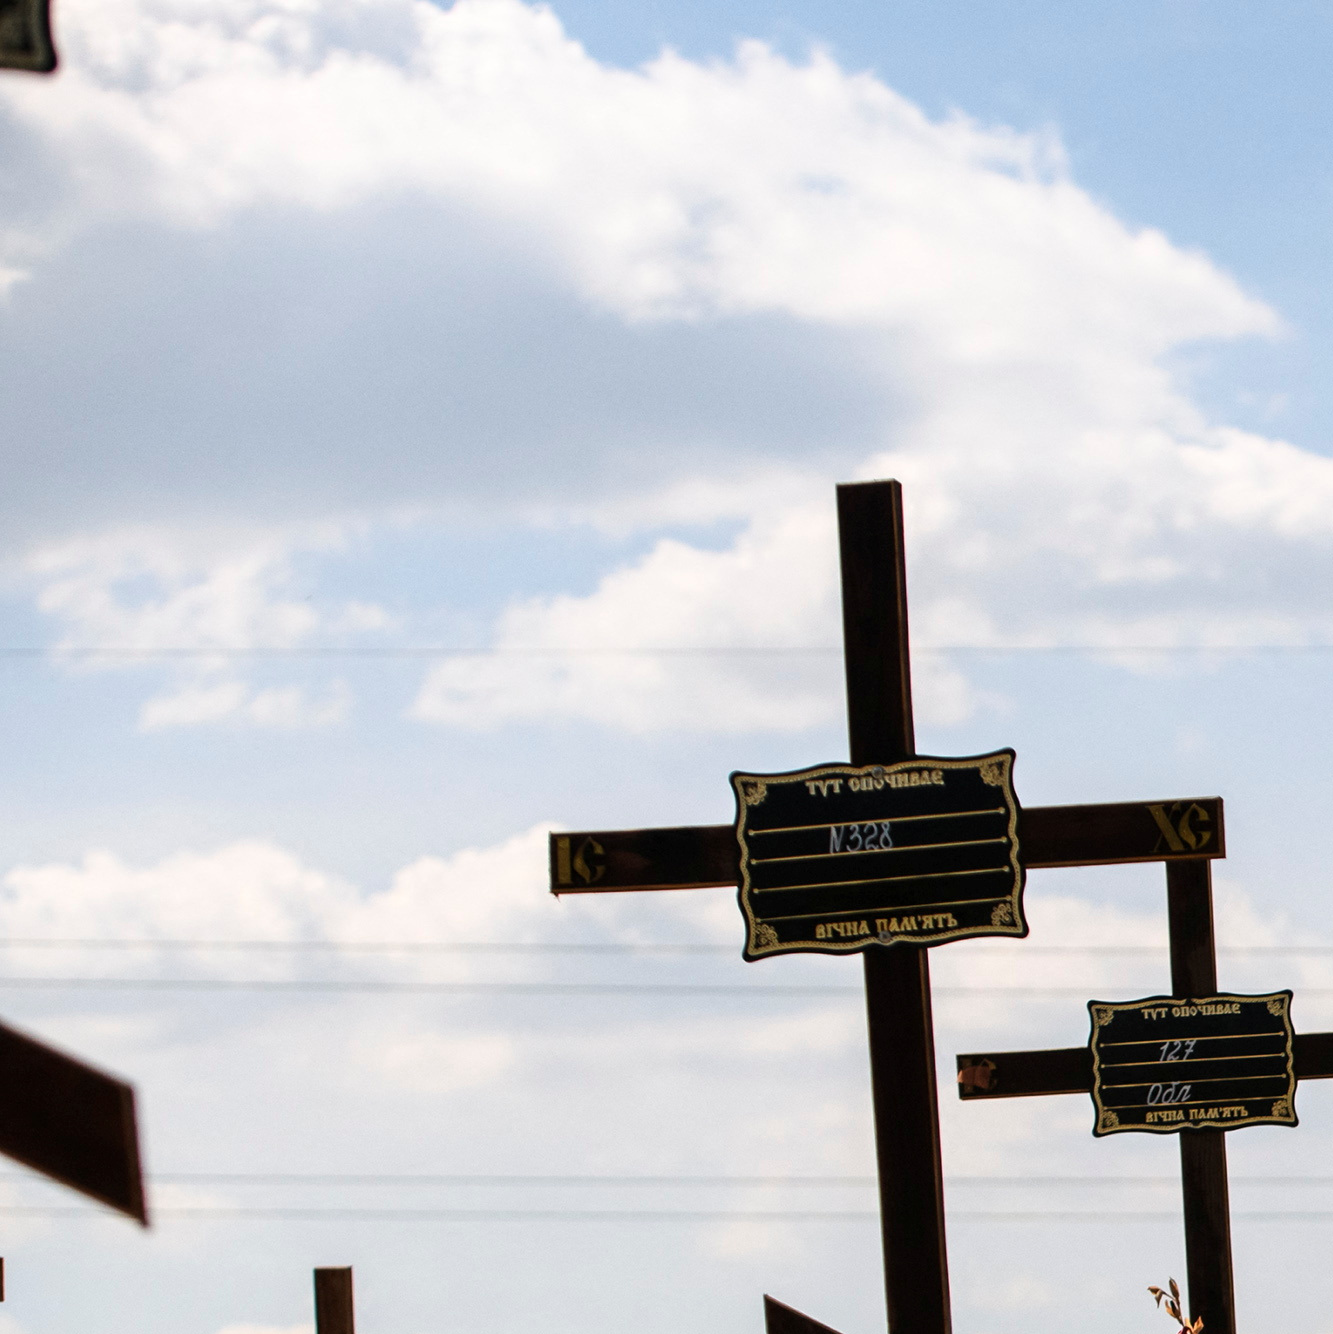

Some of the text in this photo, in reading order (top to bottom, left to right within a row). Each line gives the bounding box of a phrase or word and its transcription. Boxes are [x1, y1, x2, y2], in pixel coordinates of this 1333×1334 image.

[805, 779, 843, 797] ТУТ
[815, 912, 957, 939] ВІЧНА ПАМ'ЯТЬ
[1141, 1003, 1241, 1021] ТУТ ОПОЧИВАЄ
[1159, 1039, 1197, 1062] 127
[1145, 1106, 1249, 1123] ВІЧНА ПАМ'ЯТЬ
